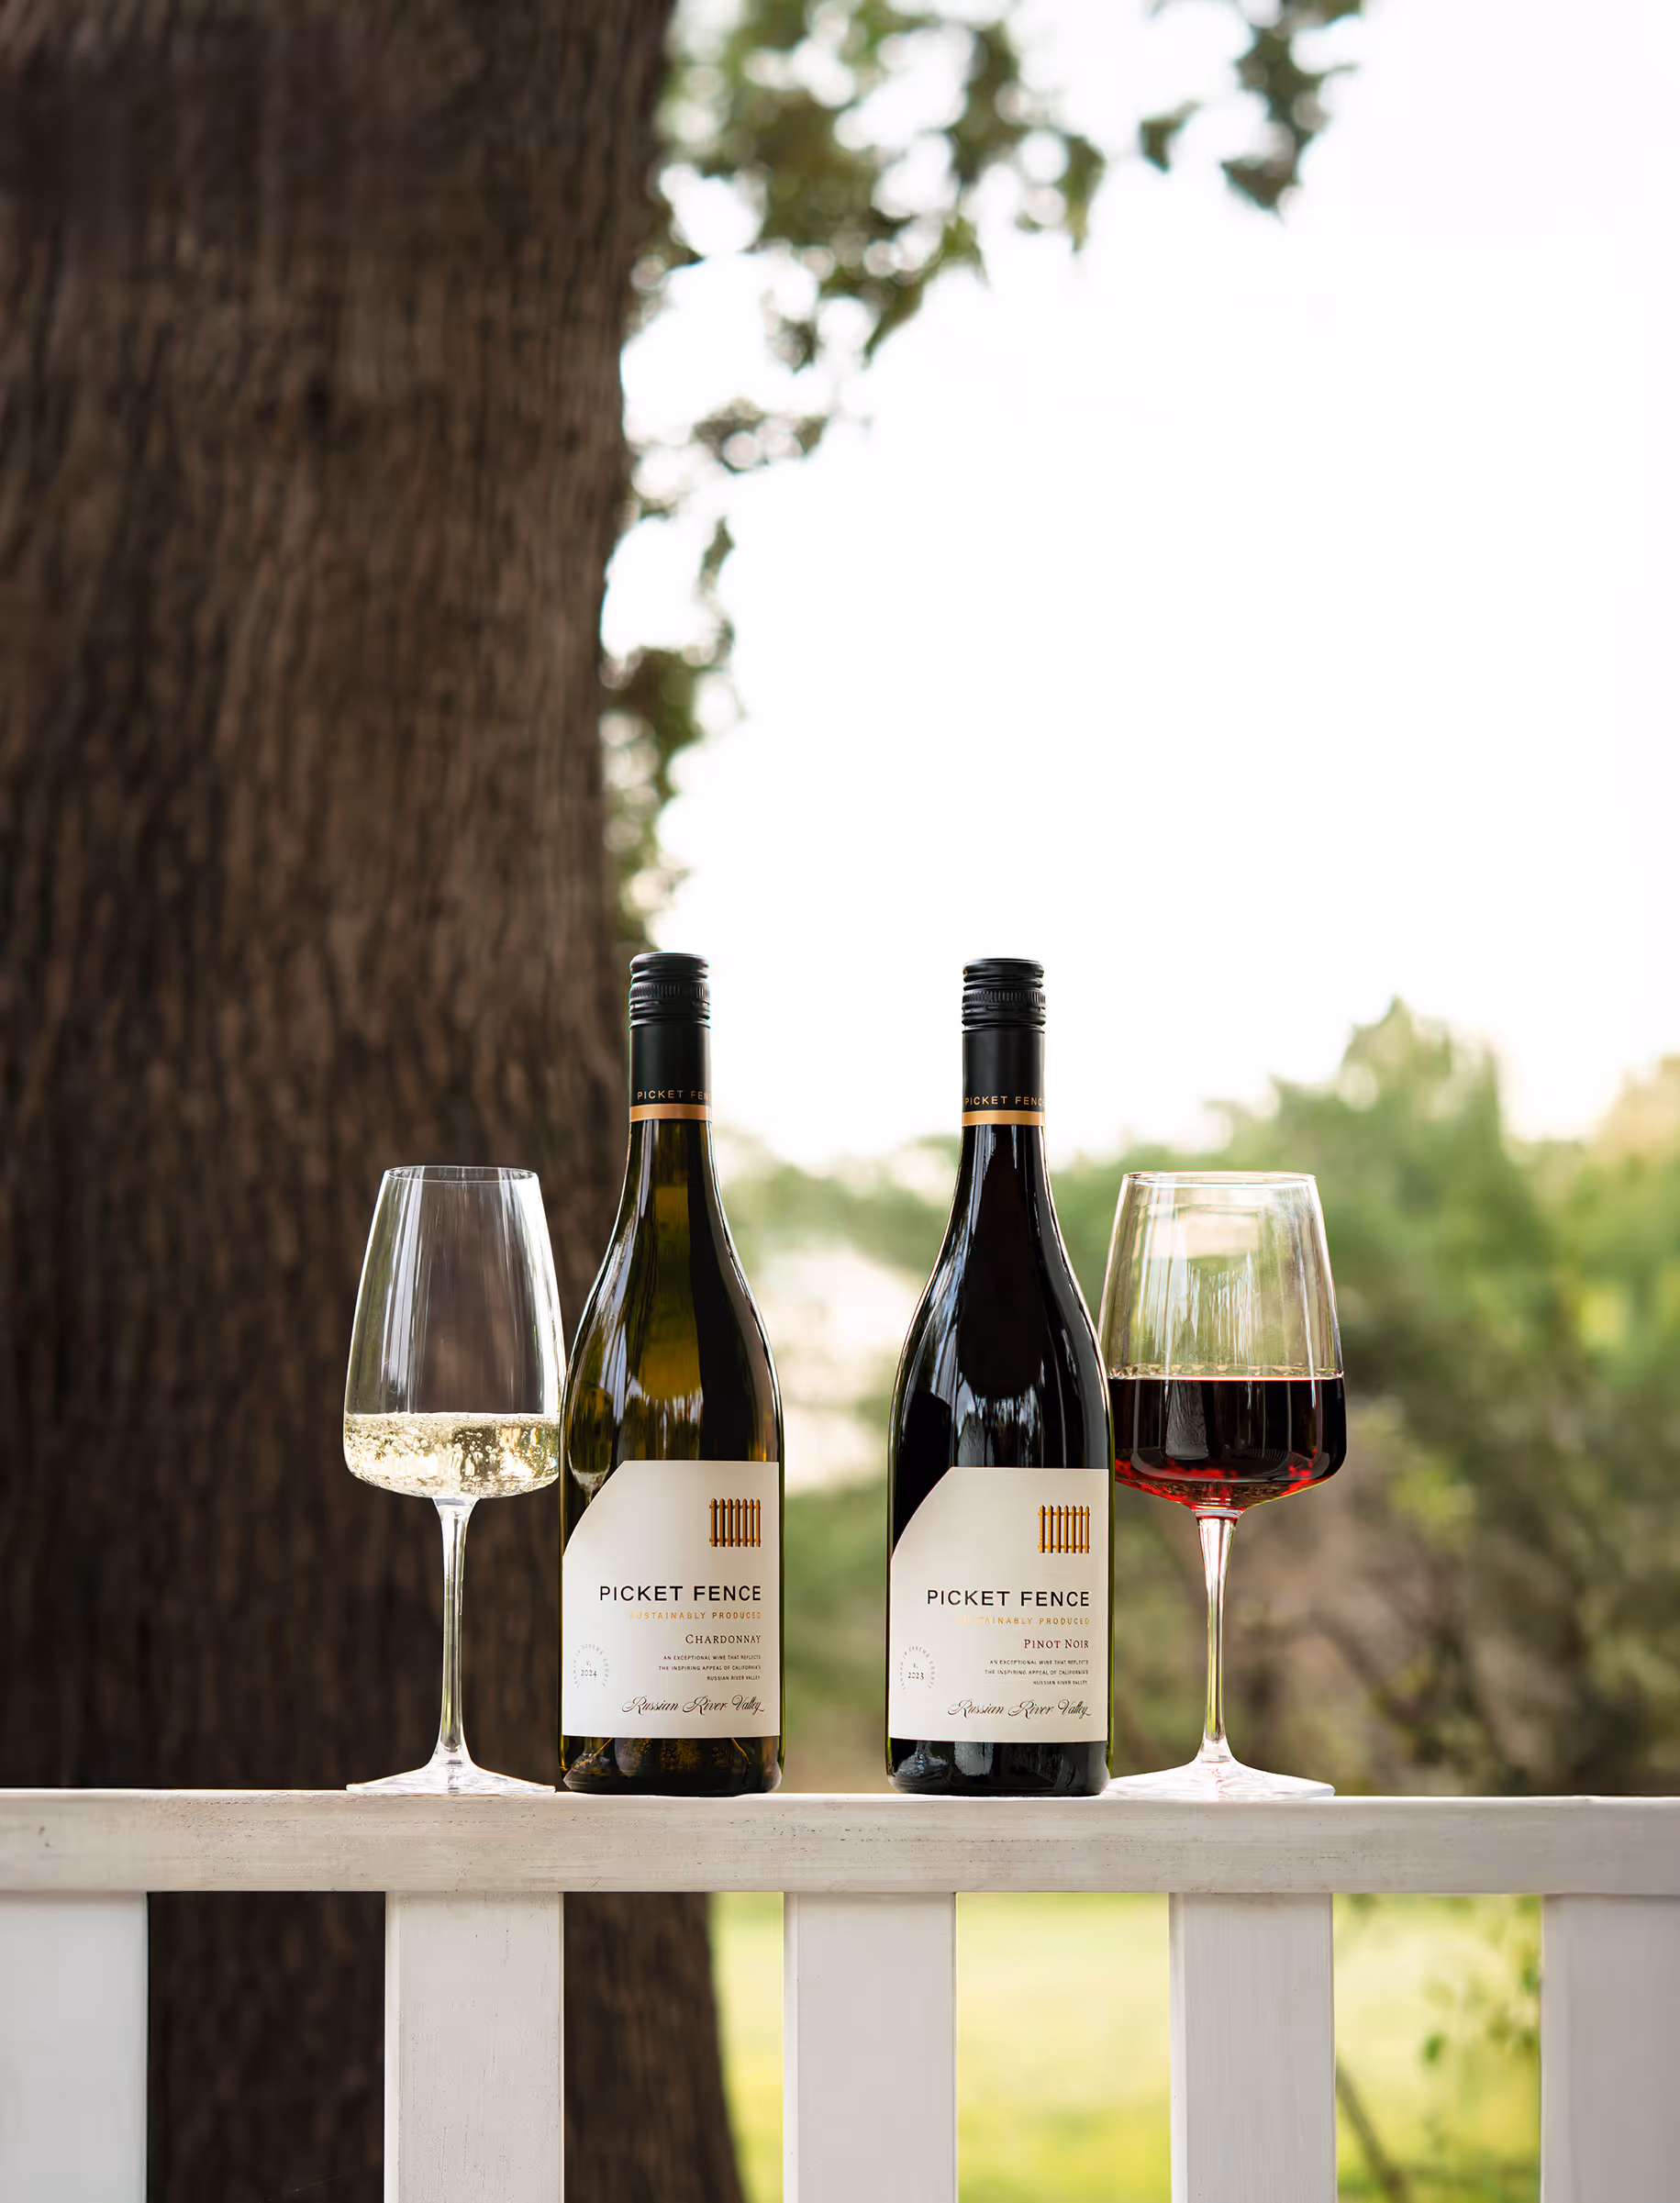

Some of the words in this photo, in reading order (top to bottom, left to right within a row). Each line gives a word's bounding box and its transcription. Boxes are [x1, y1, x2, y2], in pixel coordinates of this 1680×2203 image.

[637, 1090, 684, 1100] PICKET
[964, 1096, 1008, 1106] PICKET
[599, 1585, 684, 1601] PICKET
[693, 1585, 762, 1601] FENCE
[927, 1589, 1010, 1607] PICKET
[1020, 1591, 1090, 1607] FENCE
[629, 1611, 706, 1619] SUSTAINABLY
[712, 1611, 762, 1619] PRODUCED
[1039, 1617, 1090, 1625] PRODUCED
[580, 1669, 597, 1677] 2024
[907, 1672, 925, 1680] 2023
[621, 1695, 680, 1715] Russian
[682, 1695, 728, 1715] River
[730, 1694, 765, 1716] Valley
[947, 1698, 1005, 1719] Russian
[1007, 1698, 1054, 1719] River
[1057, 1698, 1092, 1719] Valley
